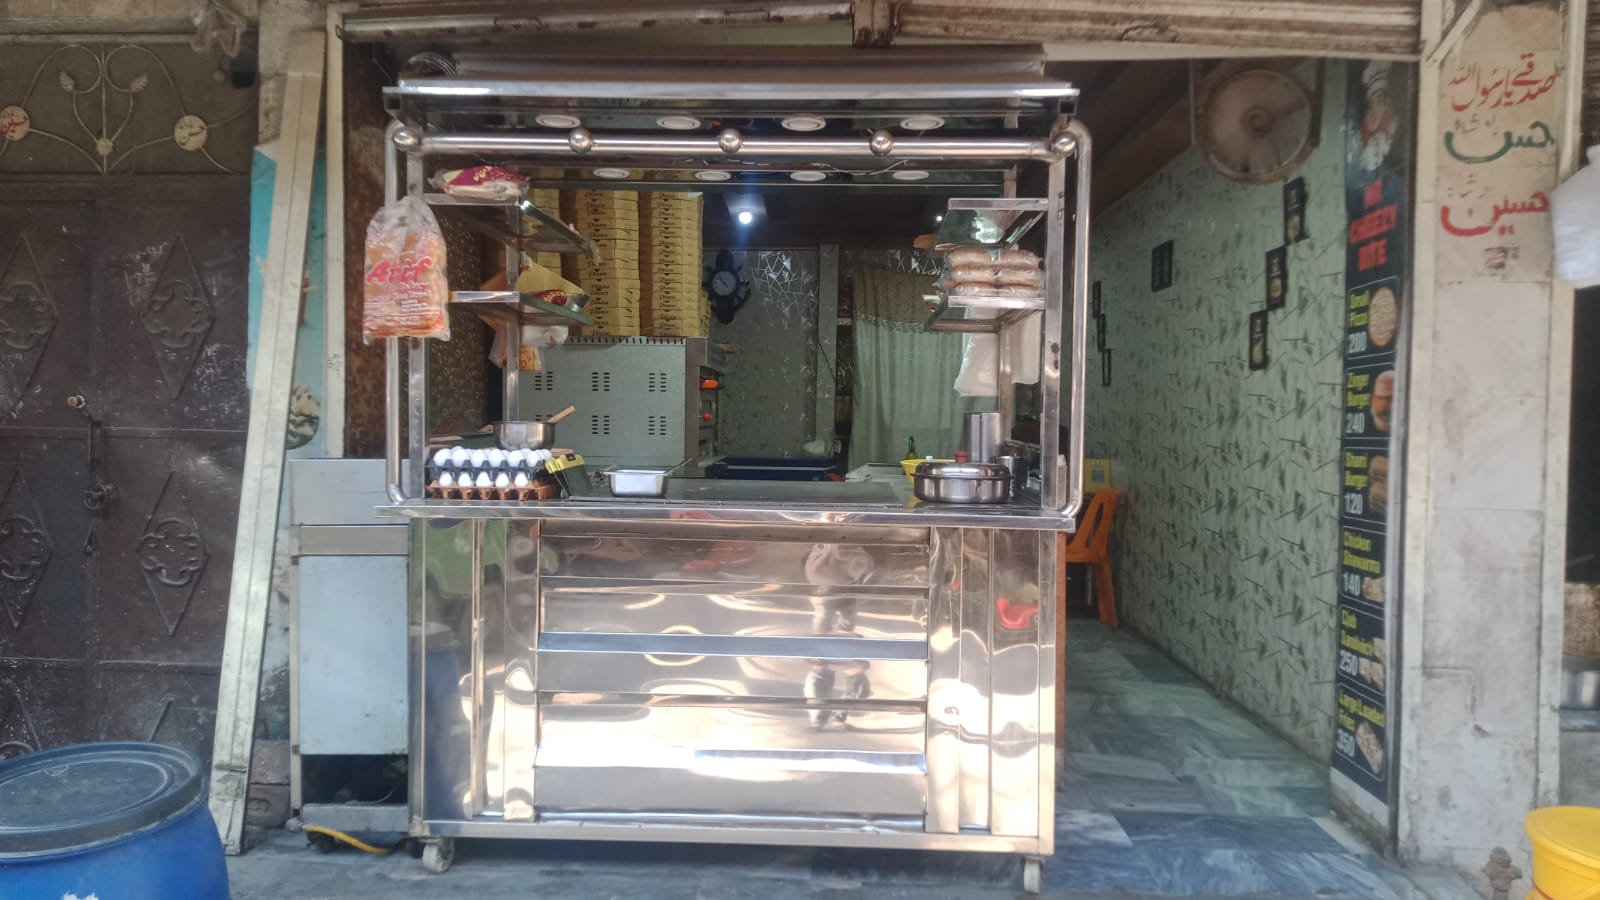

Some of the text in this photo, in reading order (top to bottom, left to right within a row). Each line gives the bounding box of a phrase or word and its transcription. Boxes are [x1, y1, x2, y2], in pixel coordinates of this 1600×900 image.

[1348, 331, 1367, 353] 200
[1346, 412, 1365, 433] 240
[1344, 493, 1363, 514] 120
[1343, 571, 1361, 596] 140
[1340, 649, 1358, 676] 250
[1336, 728, 1355, 757] 350
